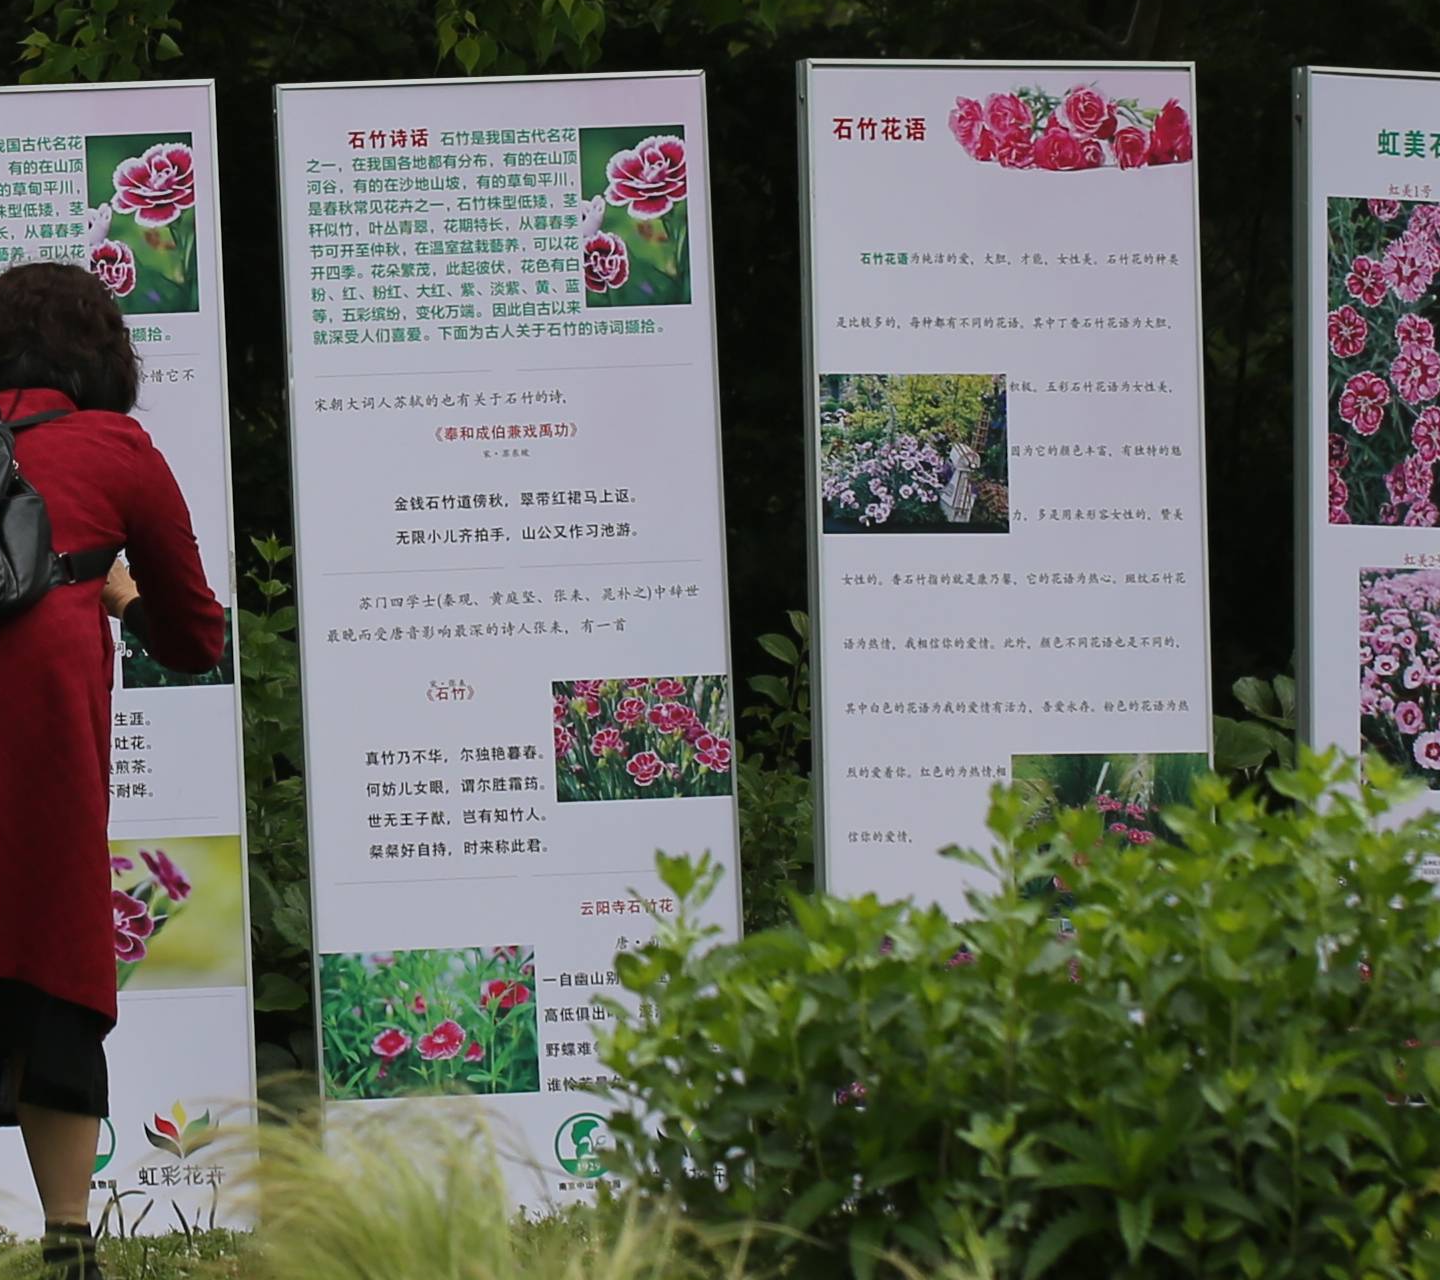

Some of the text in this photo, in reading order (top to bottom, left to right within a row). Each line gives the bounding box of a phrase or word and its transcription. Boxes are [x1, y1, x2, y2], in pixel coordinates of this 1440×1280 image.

[348, 128, 580, 149] 石竹诗话 石竹是我国古代名花
[833, 117, 926, 141] 石竹花语
[1388, 183, 1433, 199] 虹美1号
[427, 684, 474, 701] 《石竹》
[581, 897, 673, 918] 云阳寺石竹花
[139, 1164, 228, 1189] 虹彩花卉
